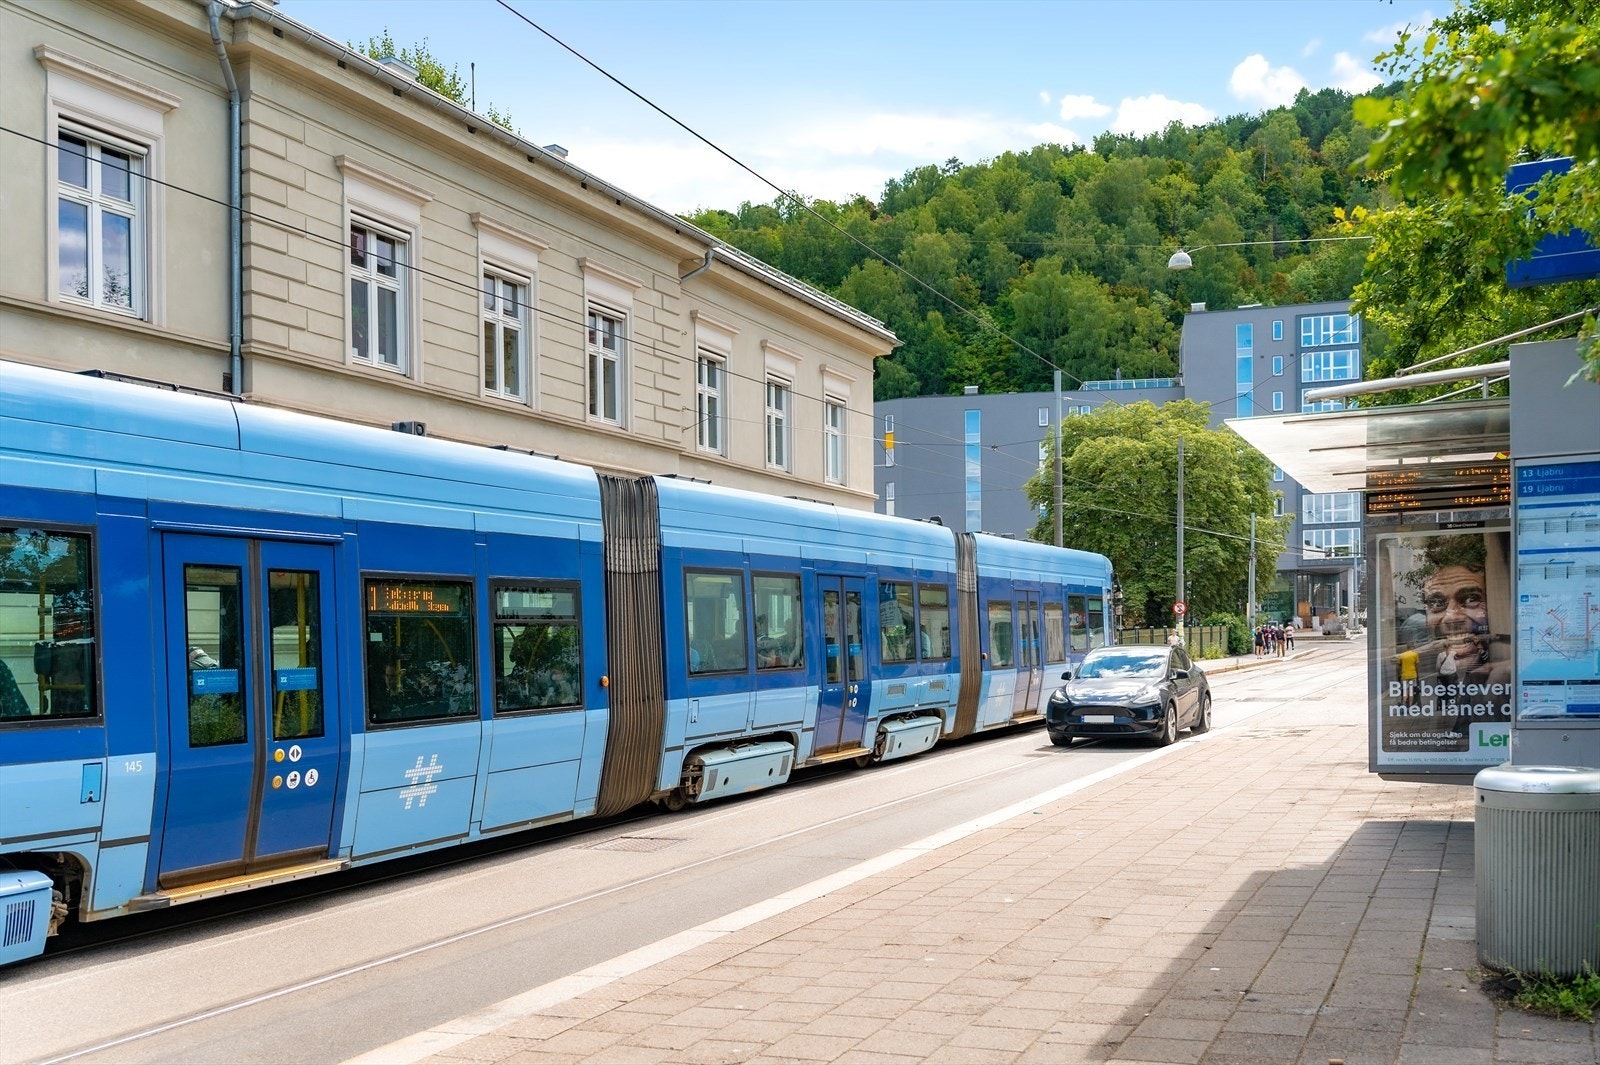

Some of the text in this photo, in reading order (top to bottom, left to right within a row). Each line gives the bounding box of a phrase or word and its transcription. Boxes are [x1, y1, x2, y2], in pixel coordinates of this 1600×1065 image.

[1522, 468, 1564, 478] 13 Ljabru
[1522, 484, 1564, 494] 19 Ljabru
[1389, 680, 1414, 697] Bli
[1389, 700, 1434, 717] med
[1441, 699, 1495, 717] lånet
[1389, 731, 1408, 739] Sjekk
[1389, 738, 1458, 747] få bedre betingelser
[124, 760, 143, 773] 145
